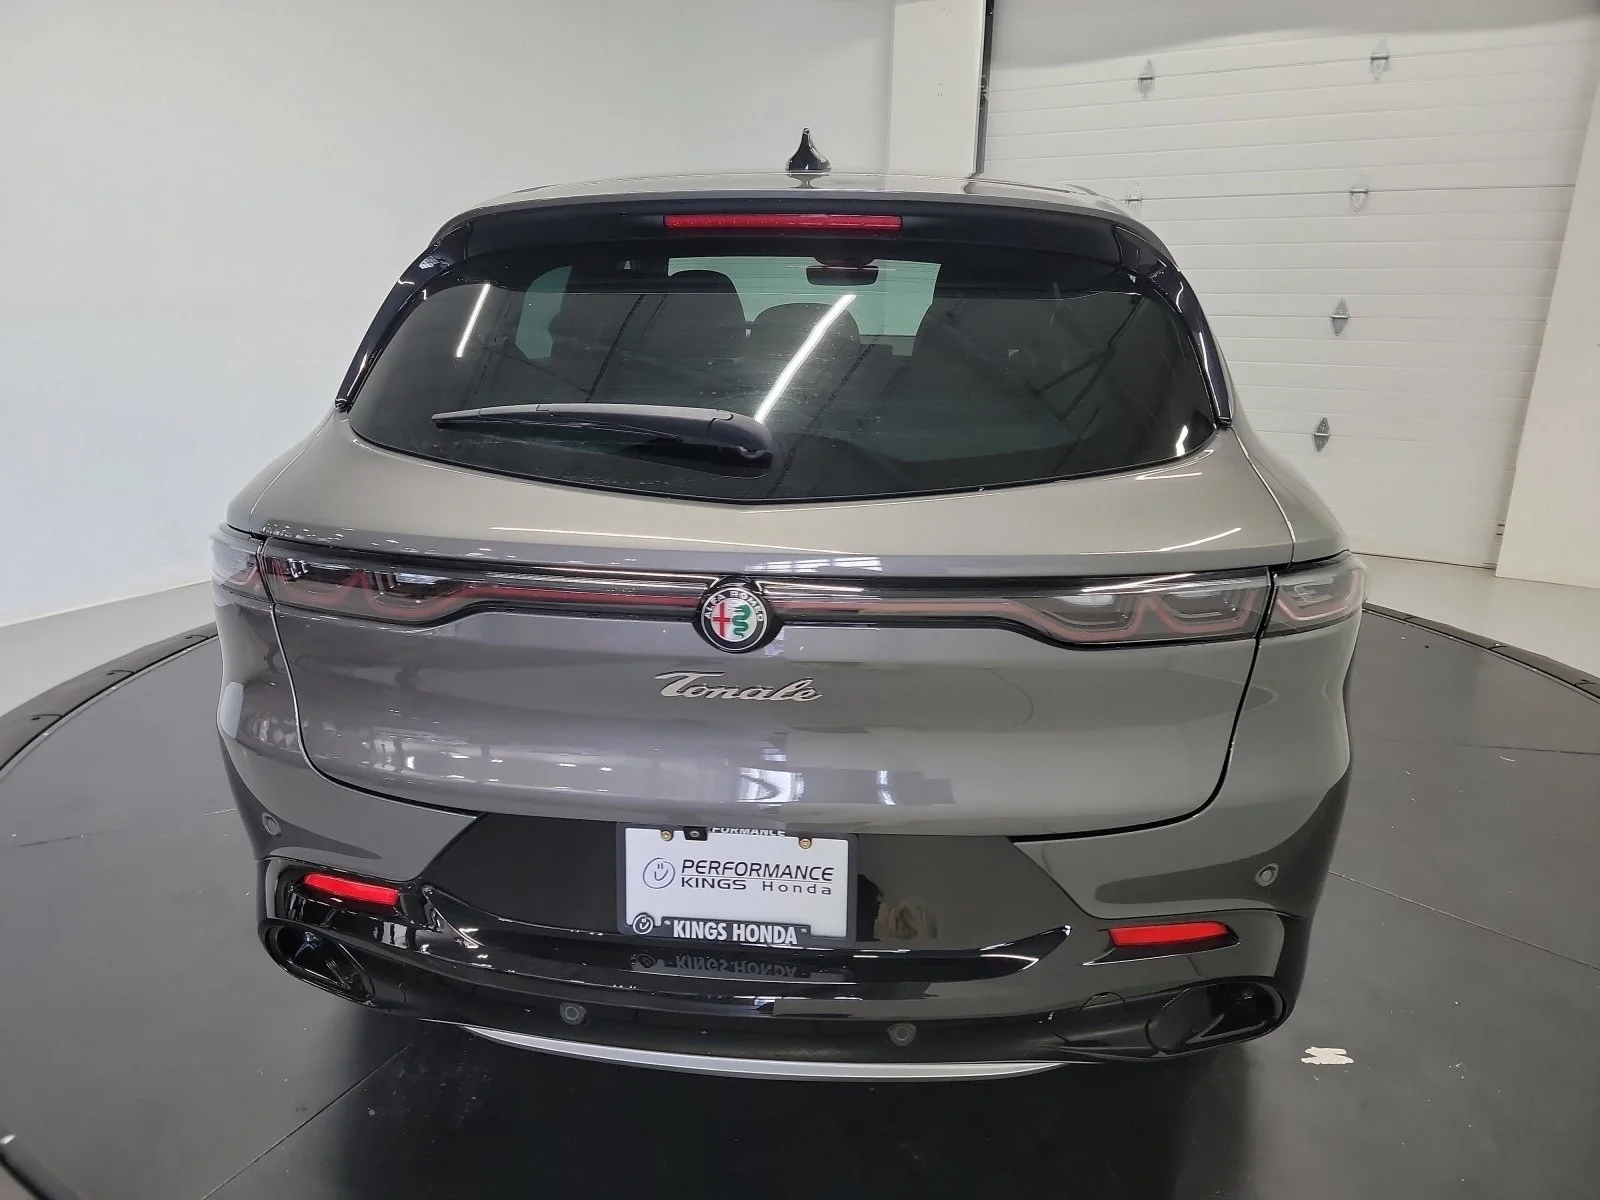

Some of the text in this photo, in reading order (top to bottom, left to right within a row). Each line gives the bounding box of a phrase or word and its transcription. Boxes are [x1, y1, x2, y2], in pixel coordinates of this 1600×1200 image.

[704, 591, 764, 622] ALFA ROMEO
[655, 671, 823, 701] Tonale
[681, 859, 835, 882] PERFORMANCE
[681, 877, 832, 895] KINGS Honda
[673, 919, 798, 945] KINGS HONDA
